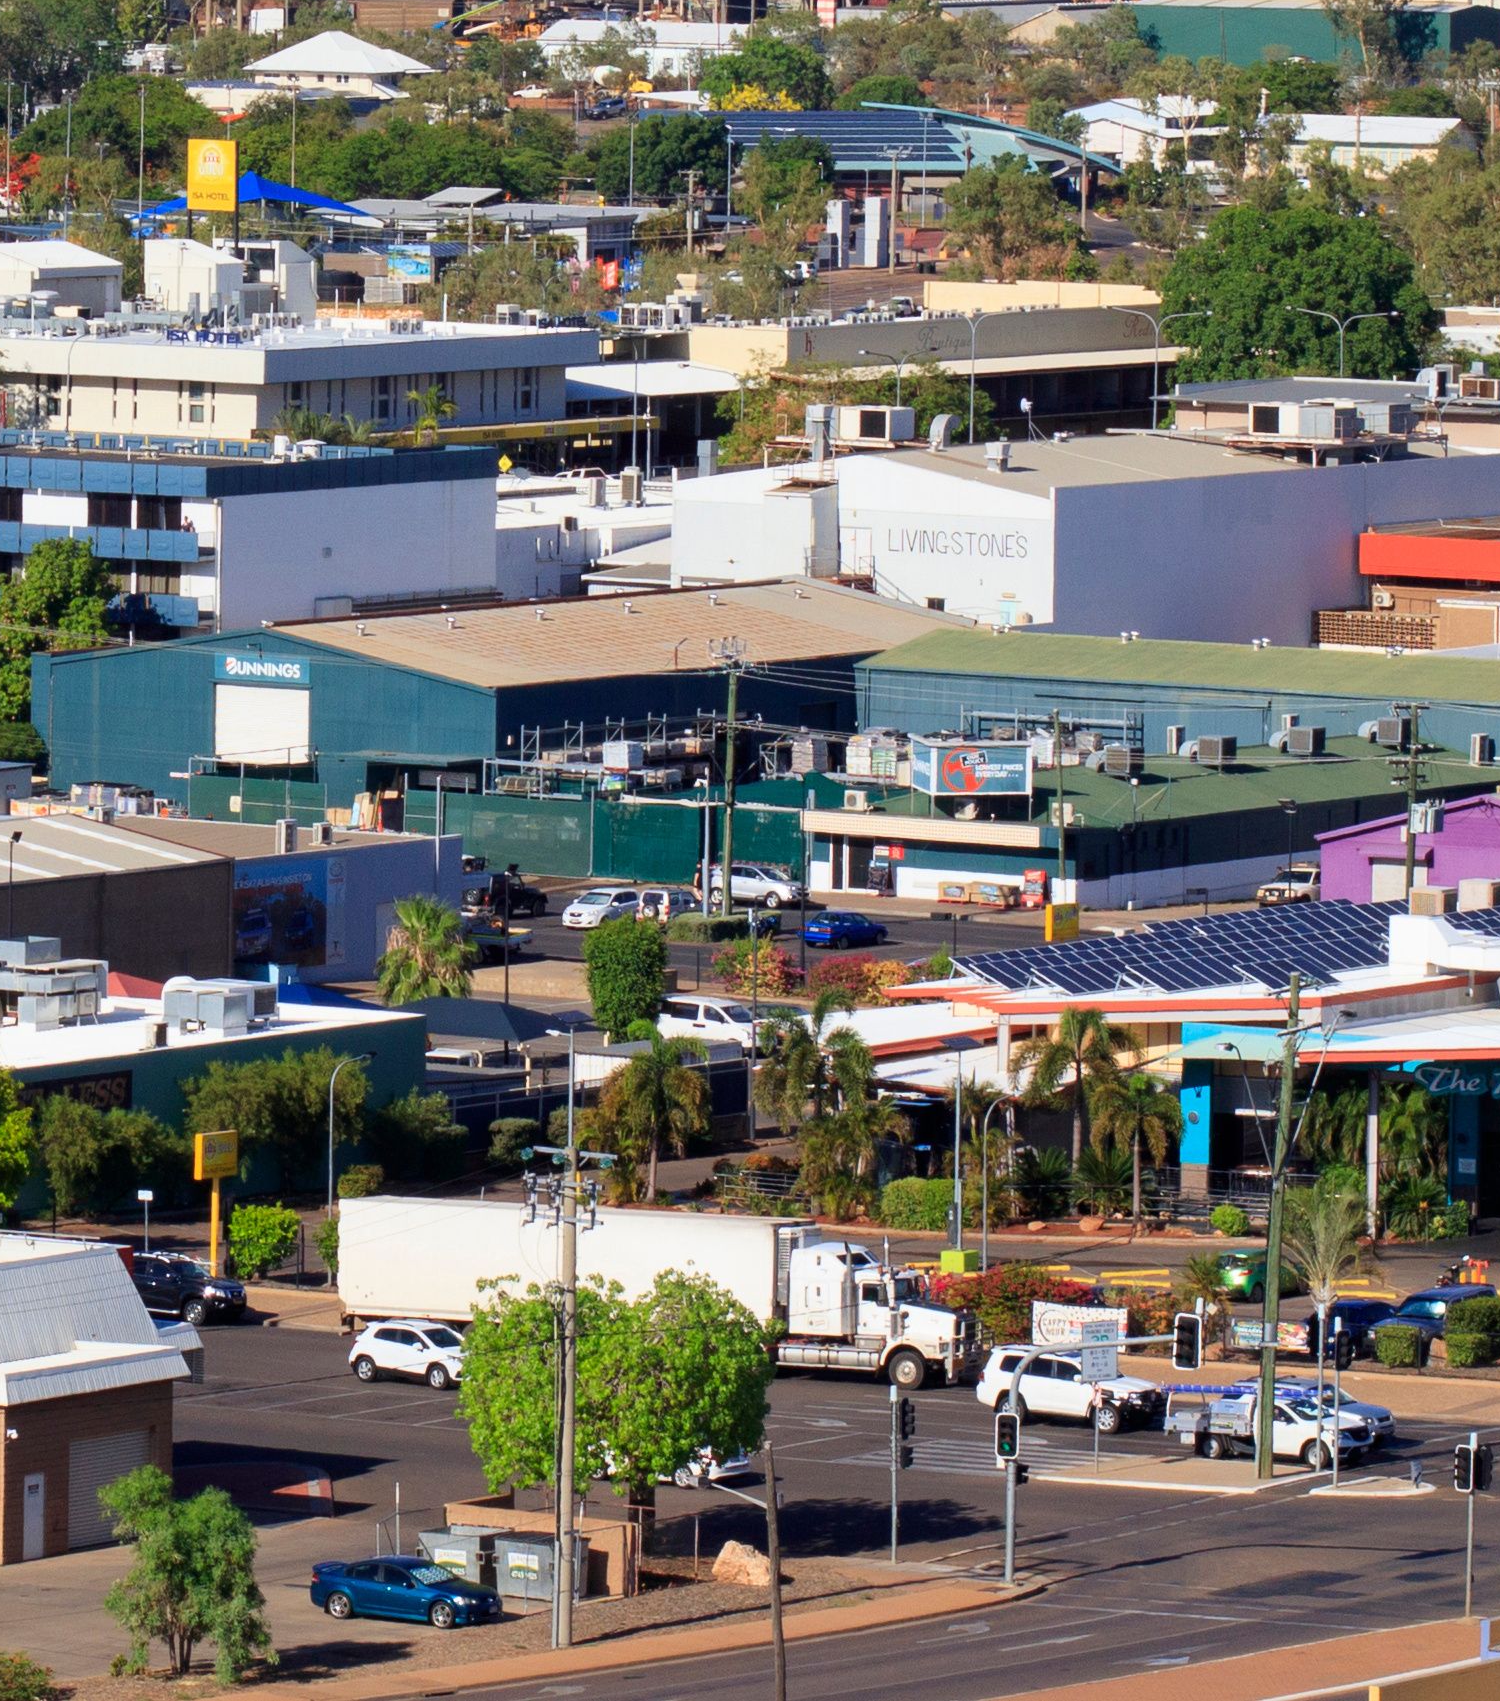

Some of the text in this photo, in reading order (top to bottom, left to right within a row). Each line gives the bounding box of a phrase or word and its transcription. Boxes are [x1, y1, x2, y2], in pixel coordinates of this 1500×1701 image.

[206, 193, 230, 201] HOTEL
[166, 329, 244, 345] ISA HOTEL
[888, 528, 1029, 563] LIVINGSTONE'S
[225, 656, 301, 680] BUNNINGS
[1414, 1066, 1481, 1096] The
